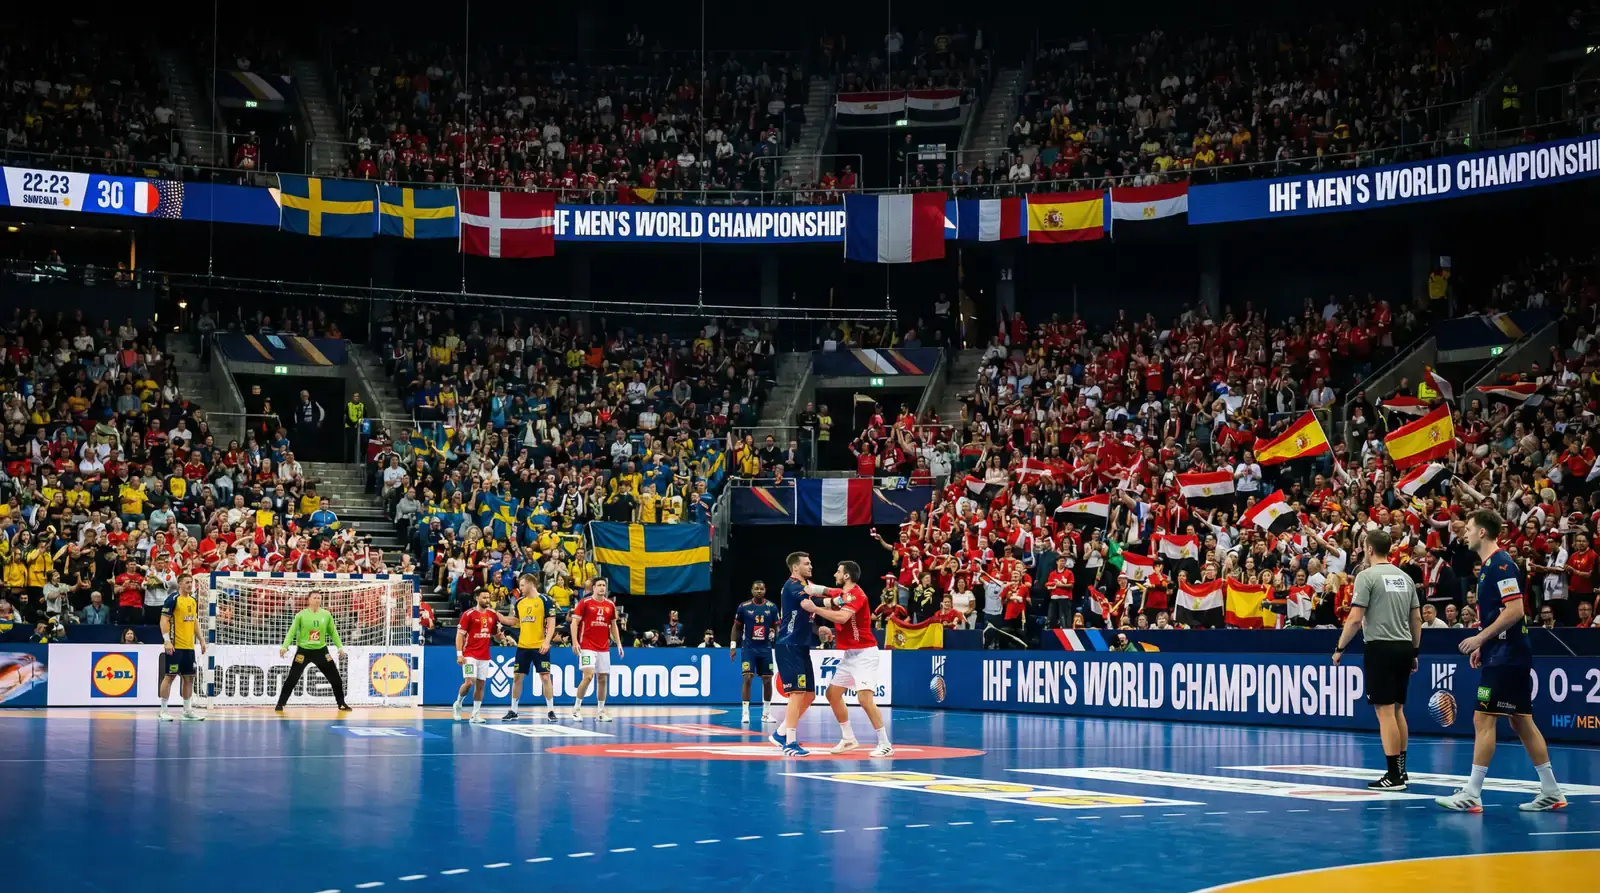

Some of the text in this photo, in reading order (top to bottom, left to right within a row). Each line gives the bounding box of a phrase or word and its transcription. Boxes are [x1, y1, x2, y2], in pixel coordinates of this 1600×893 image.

[23, 172, 69, 194] 22:23
[1269, 139, 1600, 212] IHF MEN'S WORLD CHAMPIONSHI
[574, 210, 630, 236] MEN'S
[636, 211, 703, 237] WORLD
[708, 210, 846, 238] CHAMPIONSHIP
[95, 666, 134, 681] LIDL
[1431, 663, 1458, 691] IHF
[982, 659, 1364, 717] IHF MEN'S WORLD CHAMPIONSHIP
